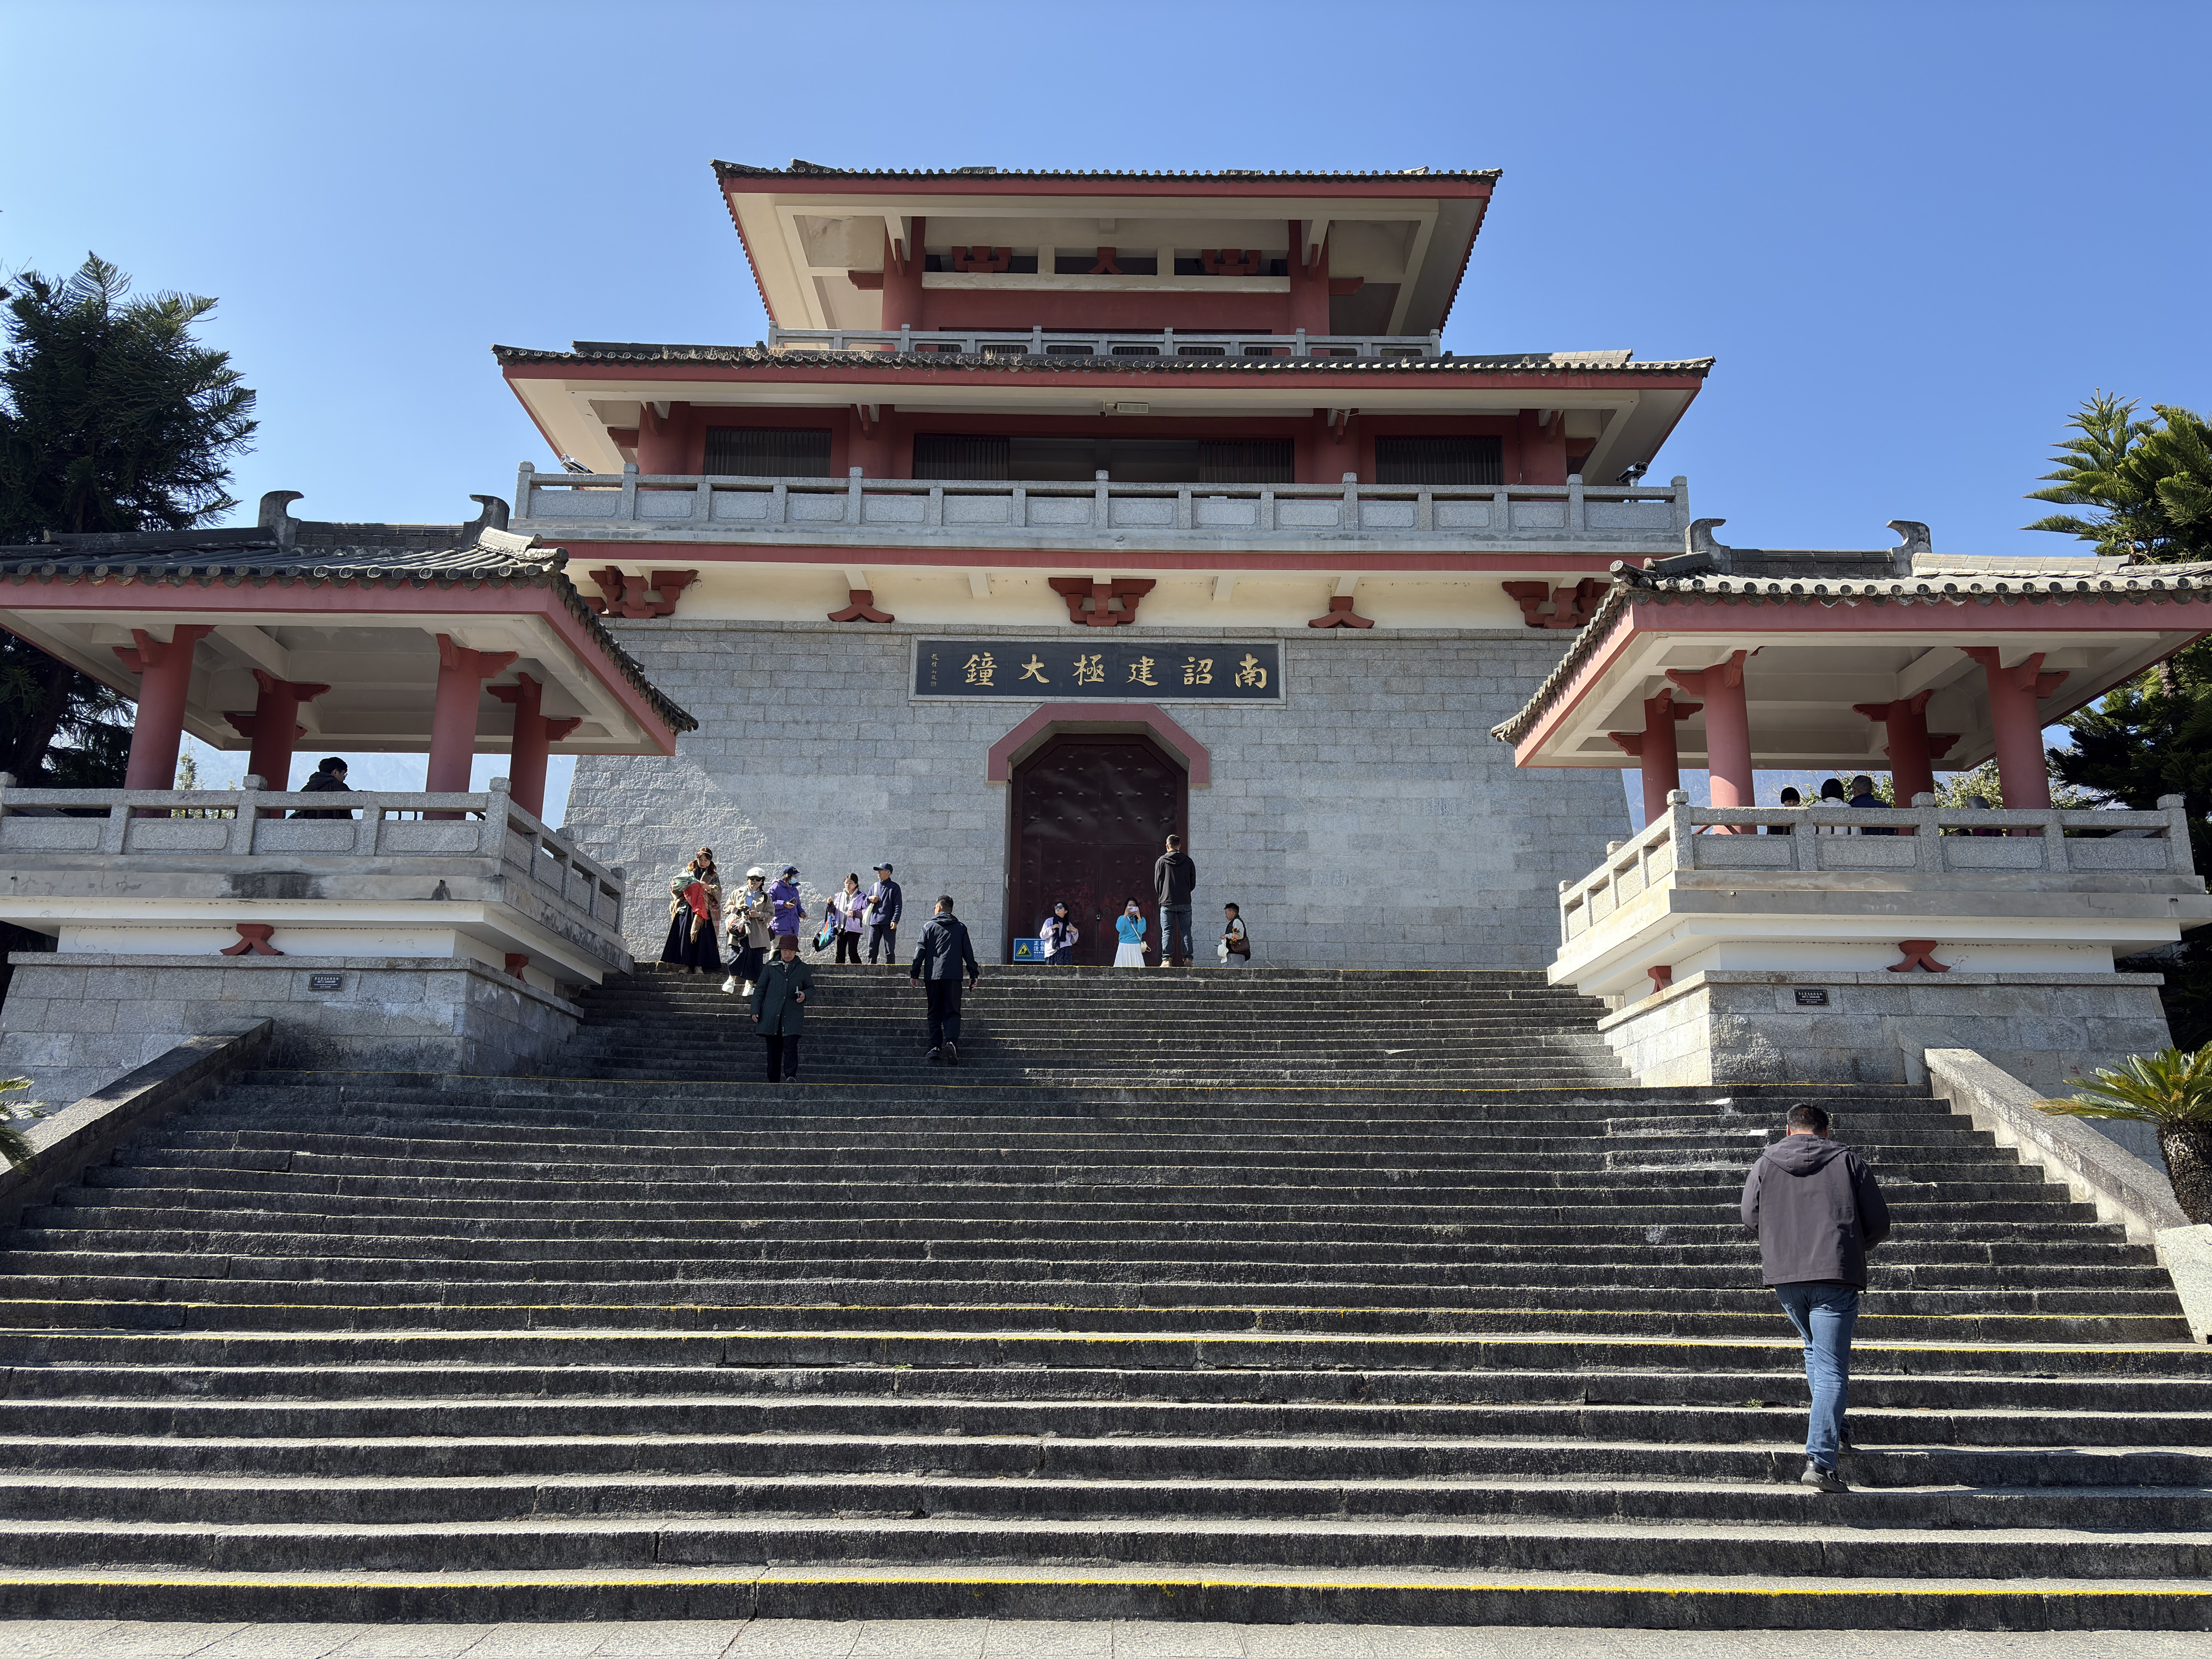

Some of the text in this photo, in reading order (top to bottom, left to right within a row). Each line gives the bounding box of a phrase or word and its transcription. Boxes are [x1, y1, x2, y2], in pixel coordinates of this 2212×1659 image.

[962, 651, 1267, 689] 南詔建極大鐘
